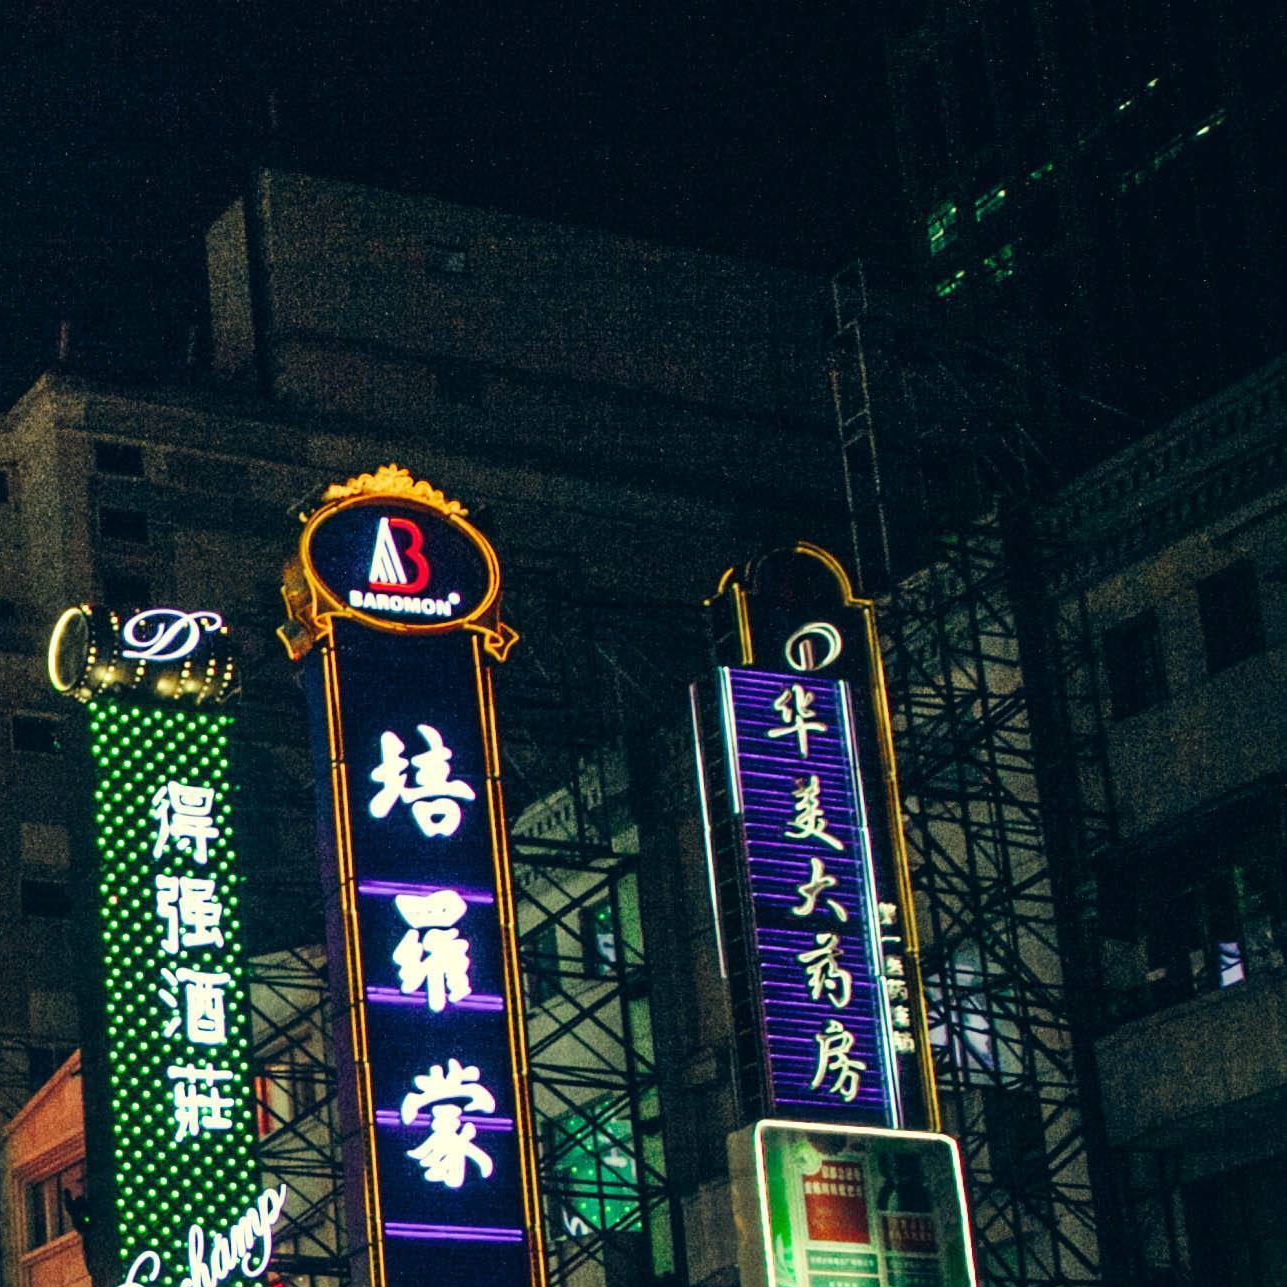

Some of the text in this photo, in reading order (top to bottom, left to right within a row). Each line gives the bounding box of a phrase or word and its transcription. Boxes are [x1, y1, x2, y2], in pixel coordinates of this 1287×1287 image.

[349, 589, 453, 617] BAROMON
[767, 683, 867, 1103] 华美大药房
